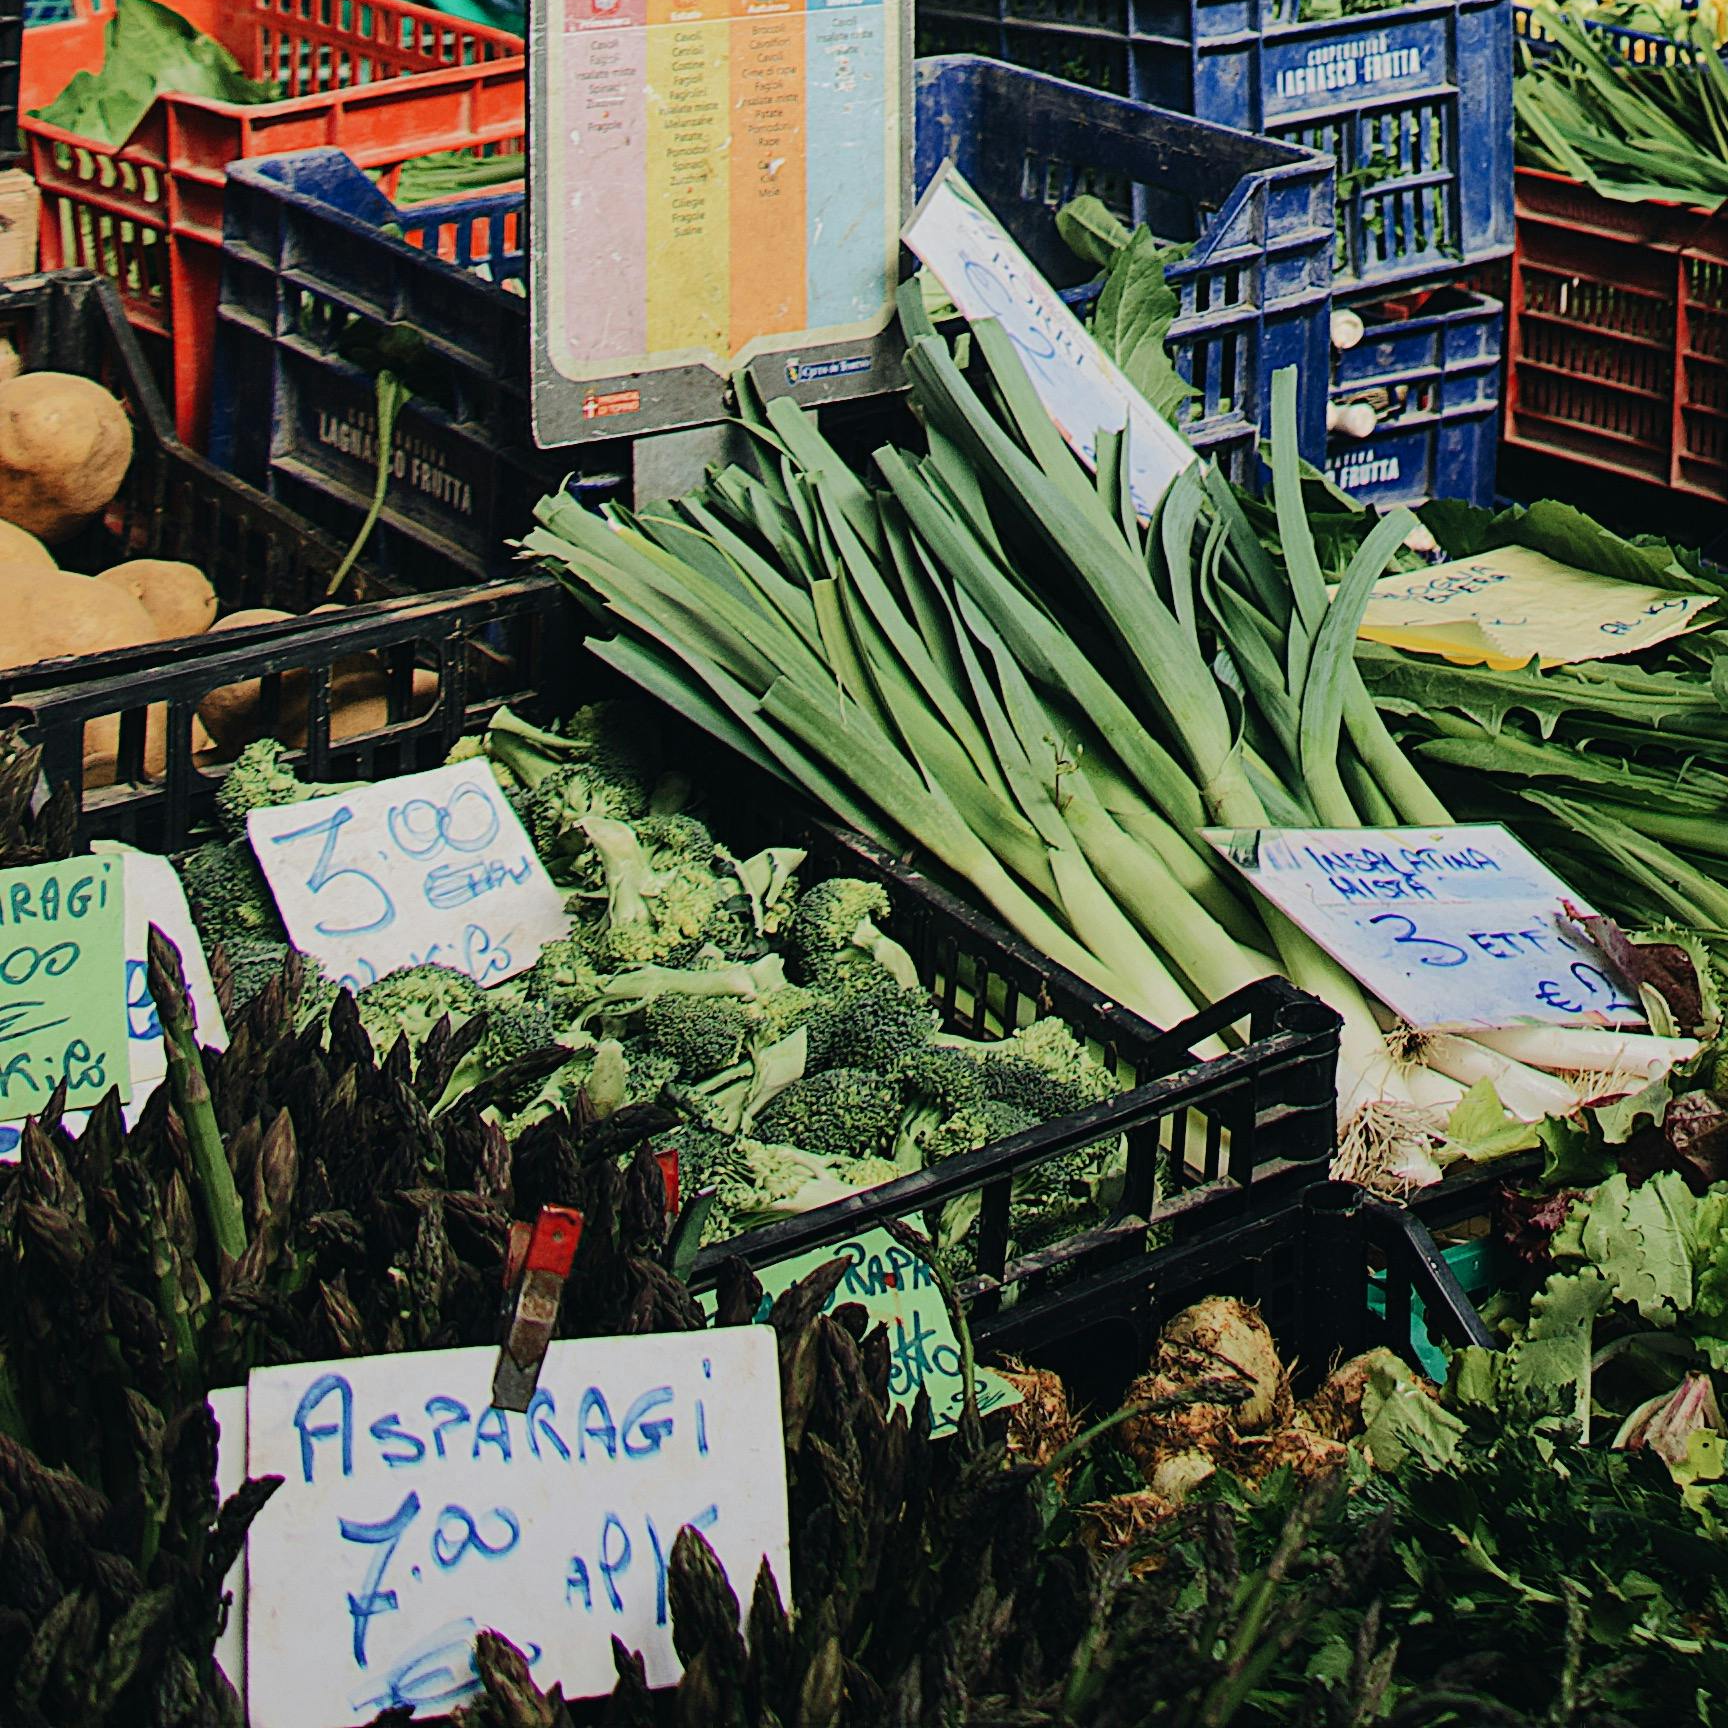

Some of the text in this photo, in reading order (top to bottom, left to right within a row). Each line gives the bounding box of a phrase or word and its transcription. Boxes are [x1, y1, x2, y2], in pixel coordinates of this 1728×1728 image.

[1363, 47, 1422, 83] FRUTTA
[411, 457, 473, 516] FRUTTA
[1339, 456, 1400, 491] FRUTTA
[1304, 844, 1502, 877] INSALATINA
[1368, 913, 1470, 968] 3
